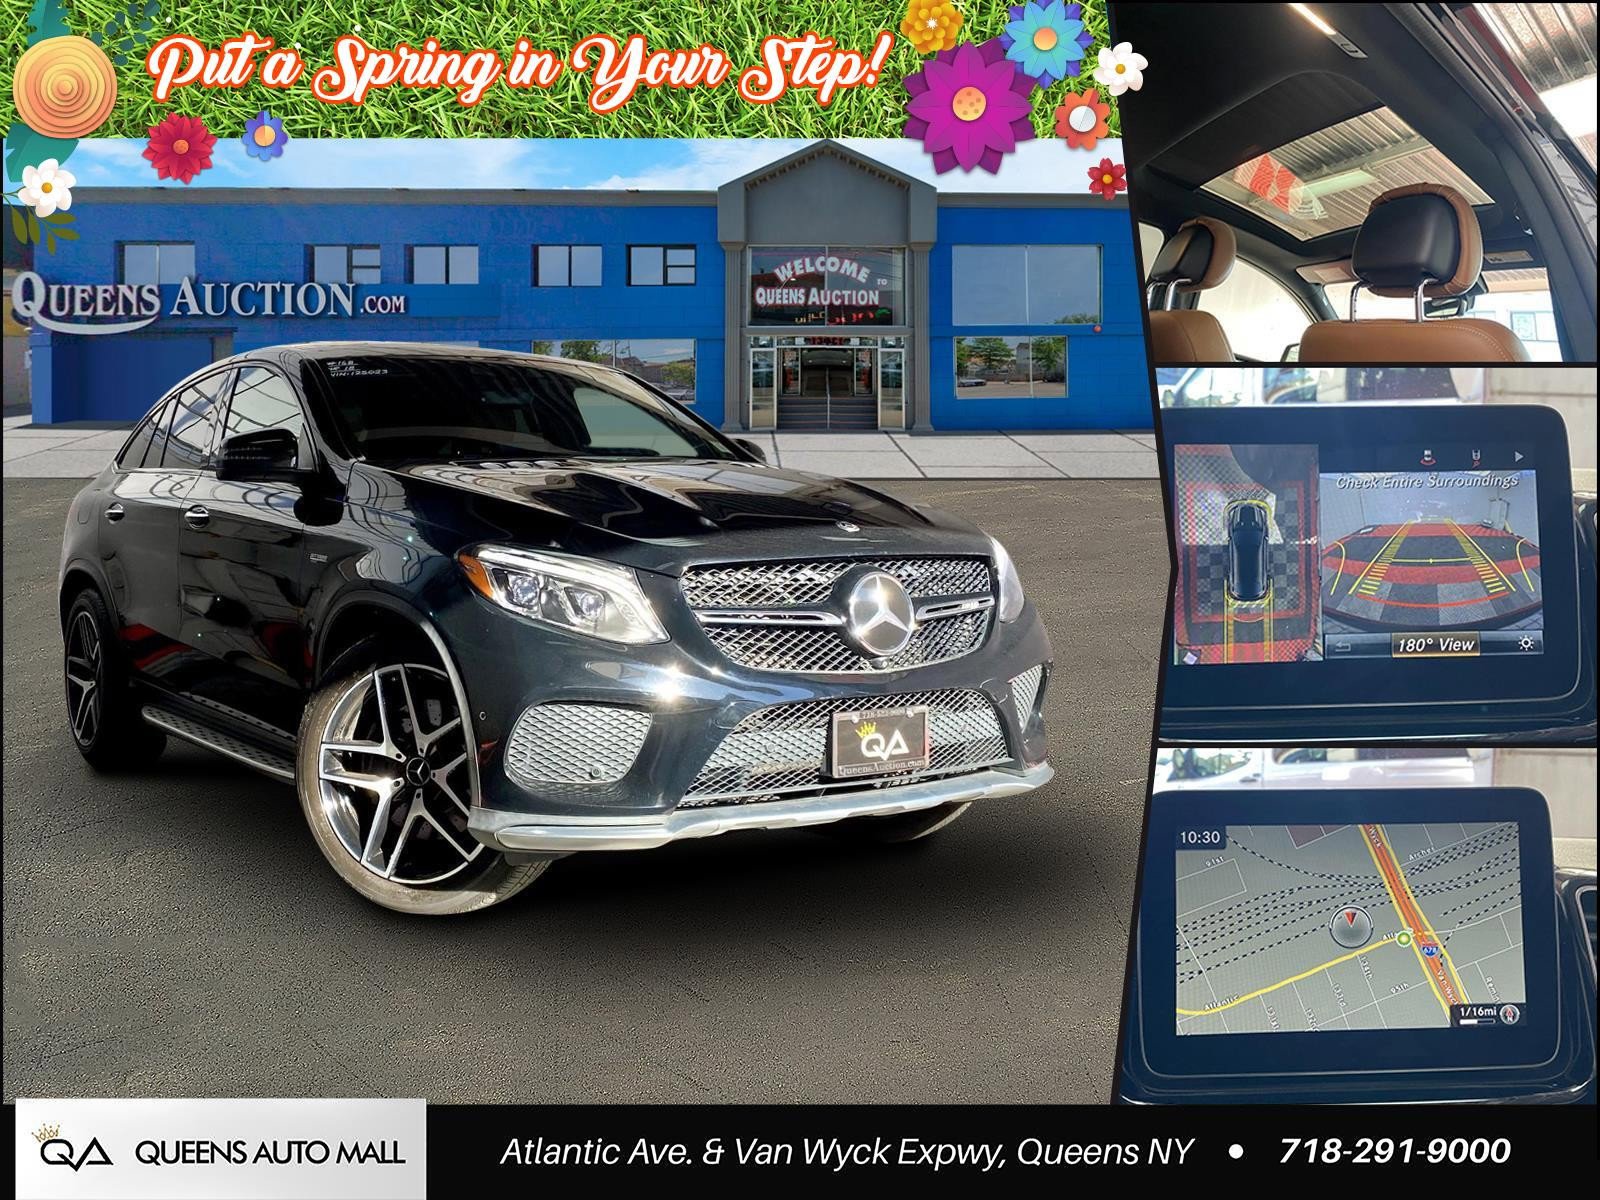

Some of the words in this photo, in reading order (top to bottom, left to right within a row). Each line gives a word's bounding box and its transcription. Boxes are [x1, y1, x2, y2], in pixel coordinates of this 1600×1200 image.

[774, 256, 871, 283] WELCOME
[12, 271, 161, 335] QUEENS
[169, 276, 357, 317] AUCTION
[360, 295, 405, 314] .COM
[755, 287, 806, 306] QUEENS
[808, 287, 879, 306] AUCTION
[1336, 476, 1379, 490] Check
[1383, 475, 1423, 488] Entire
[1427, 474, 1519, 489] Surroundings
[1399, 638, 1433, 652] 180°
[1440, 638, 1475, 651] View
[1180, 830, 1221, 844] 10:30
[1204, 993, 1240, 1011] Atlantic
[1460, 1006, 1497, 1016] 1/16mi
